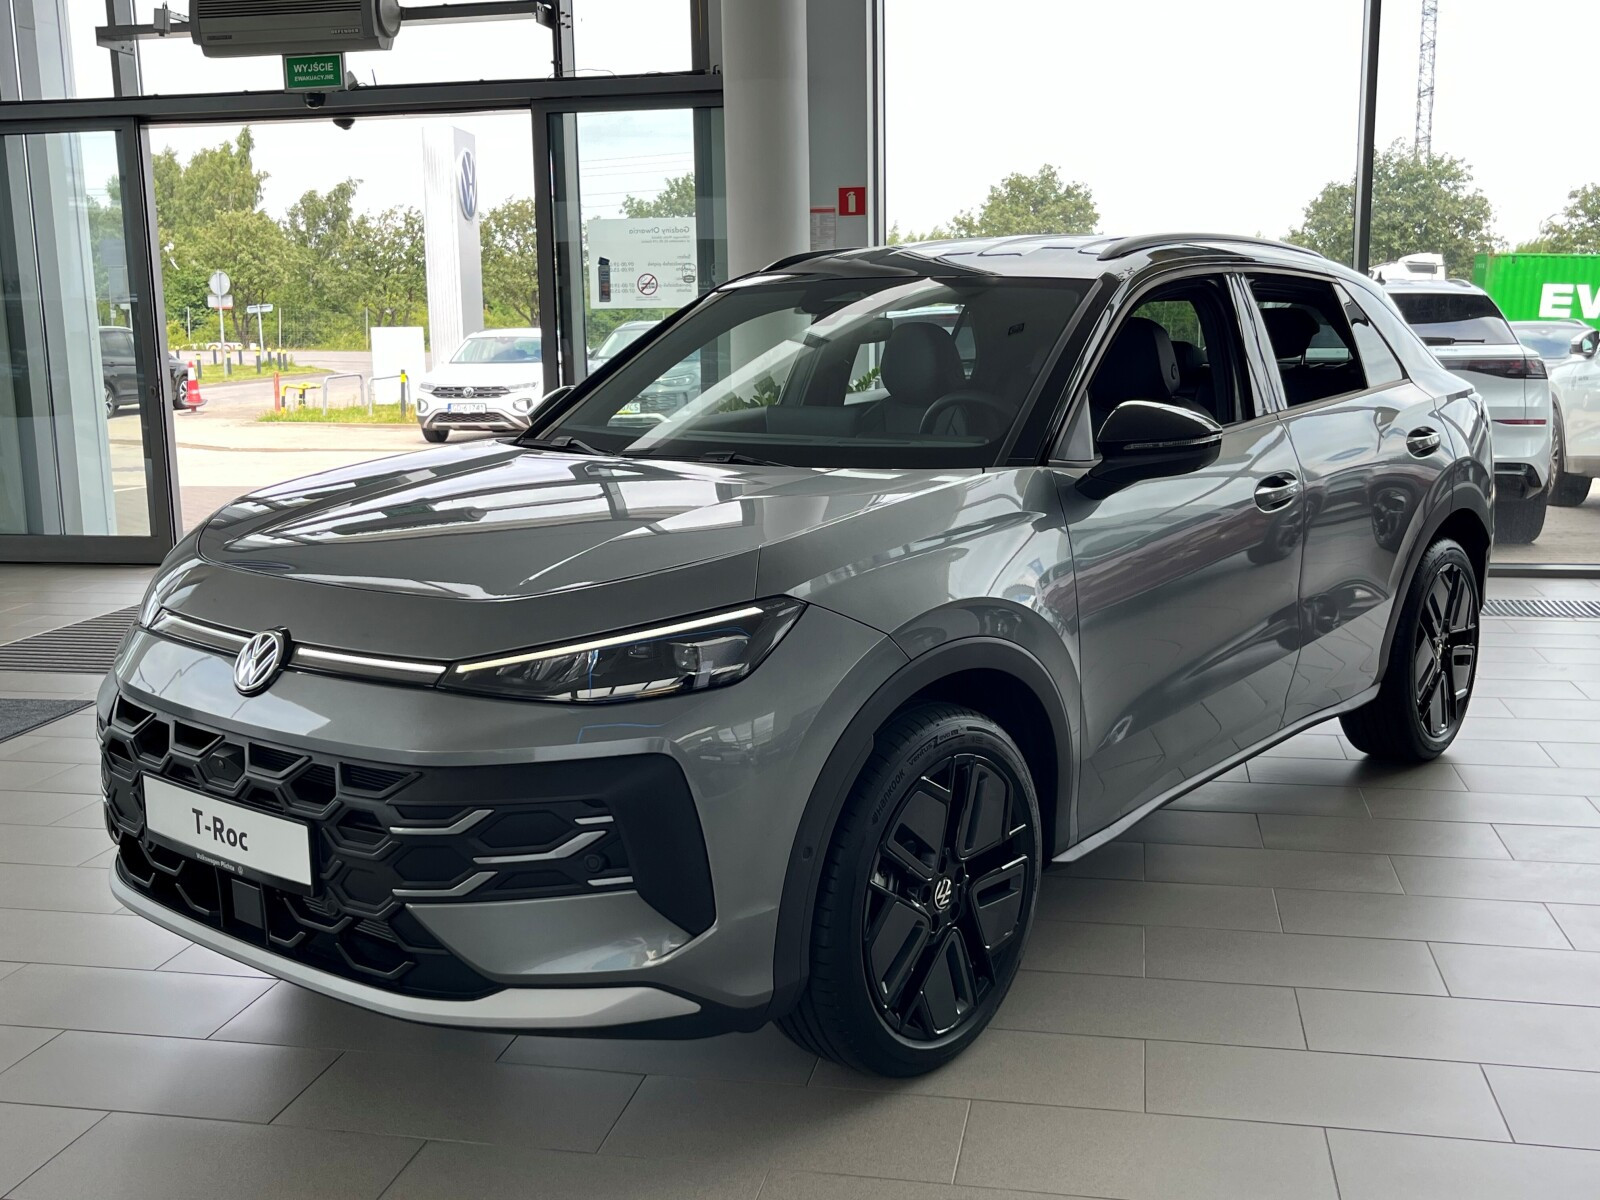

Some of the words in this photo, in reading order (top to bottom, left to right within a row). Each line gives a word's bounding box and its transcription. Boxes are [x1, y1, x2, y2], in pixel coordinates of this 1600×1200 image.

[294, 62, 334, 73] WYJŚCIE
[294, 74, 335, 82] EWAKUACYJNE
[1538, 283, 1600, 319] EV
[191, 807, 249, 851] T-Roc
